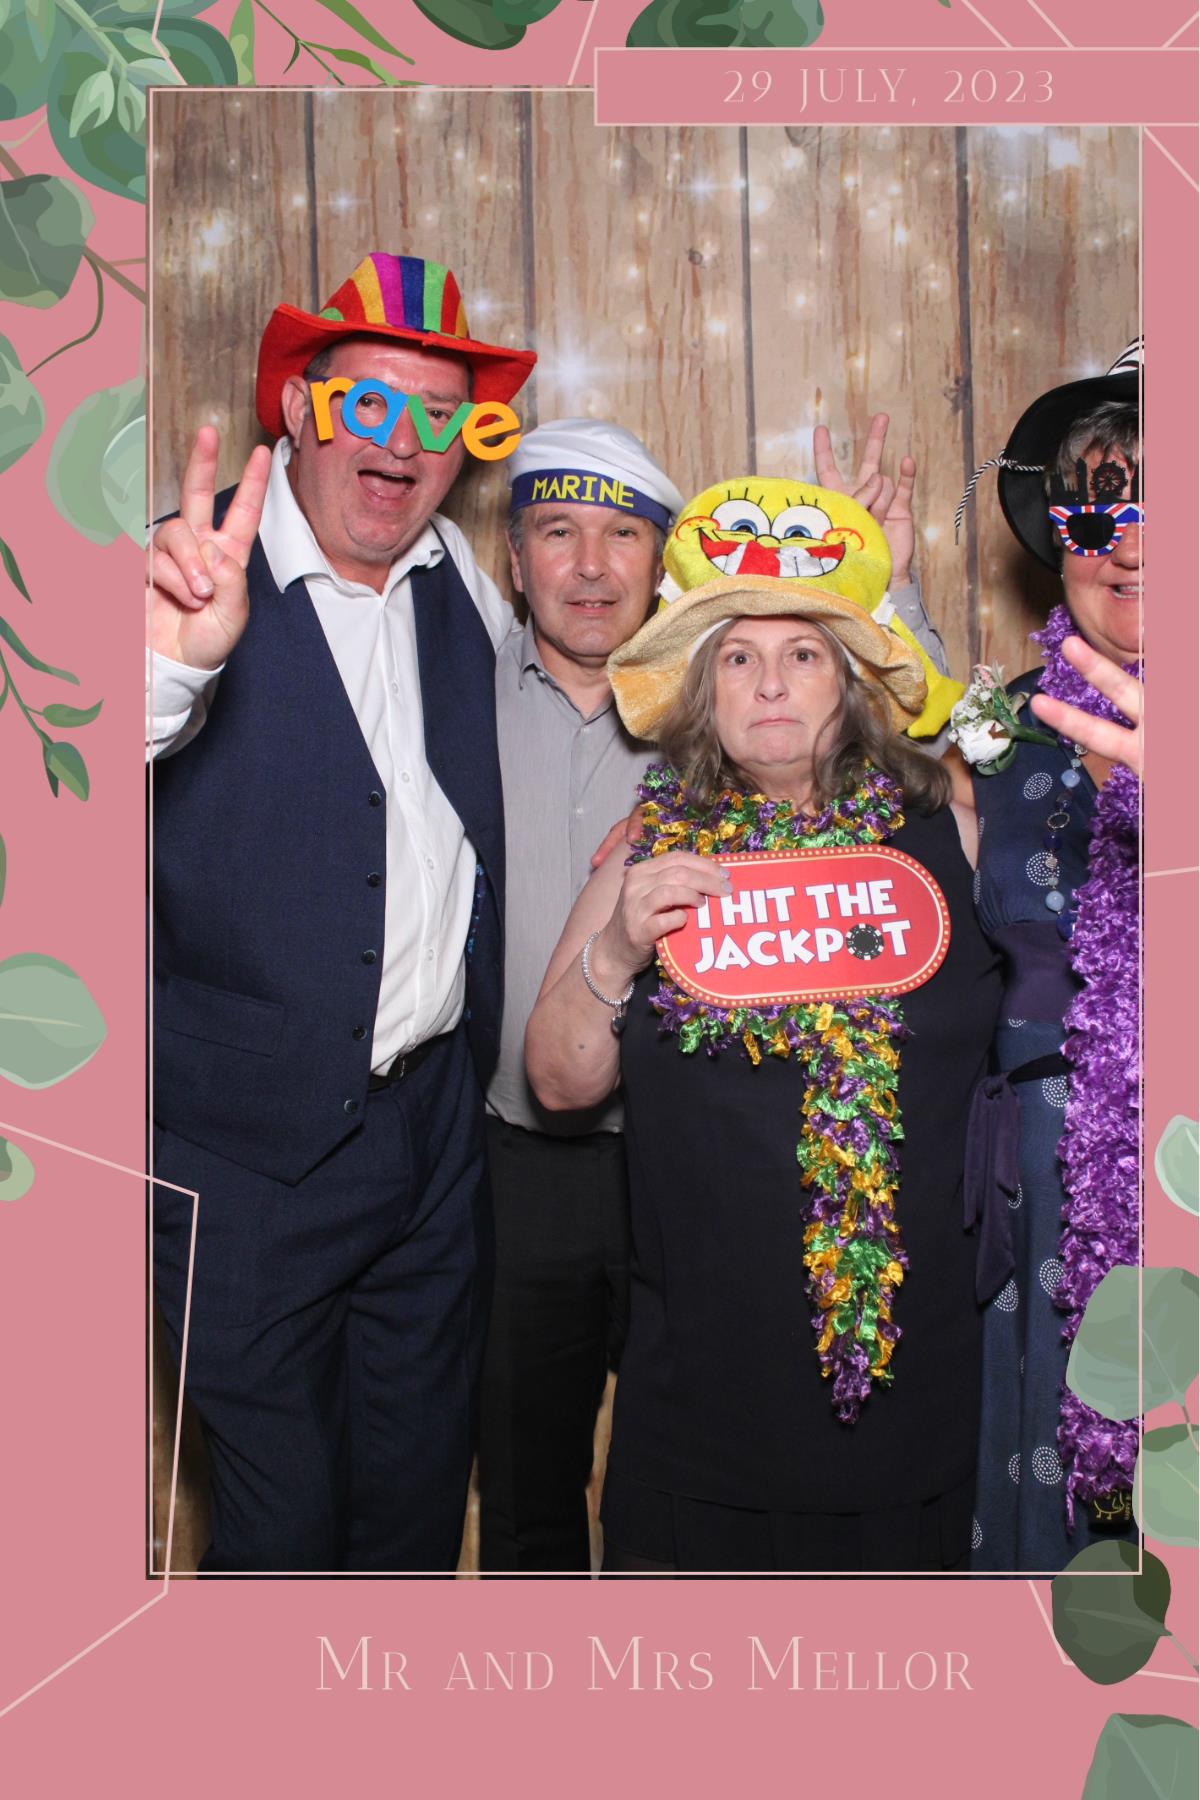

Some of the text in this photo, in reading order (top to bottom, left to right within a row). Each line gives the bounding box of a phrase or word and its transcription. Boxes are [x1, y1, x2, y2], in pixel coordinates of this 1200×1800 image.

[310, 377, 521, 461] rave
[532, 476, 635, 508] MARINE
[720, 886, 796, 927] HIT
[806, 879, 897, 920] THE
[694, 919, 912, 974] JACKPOT
